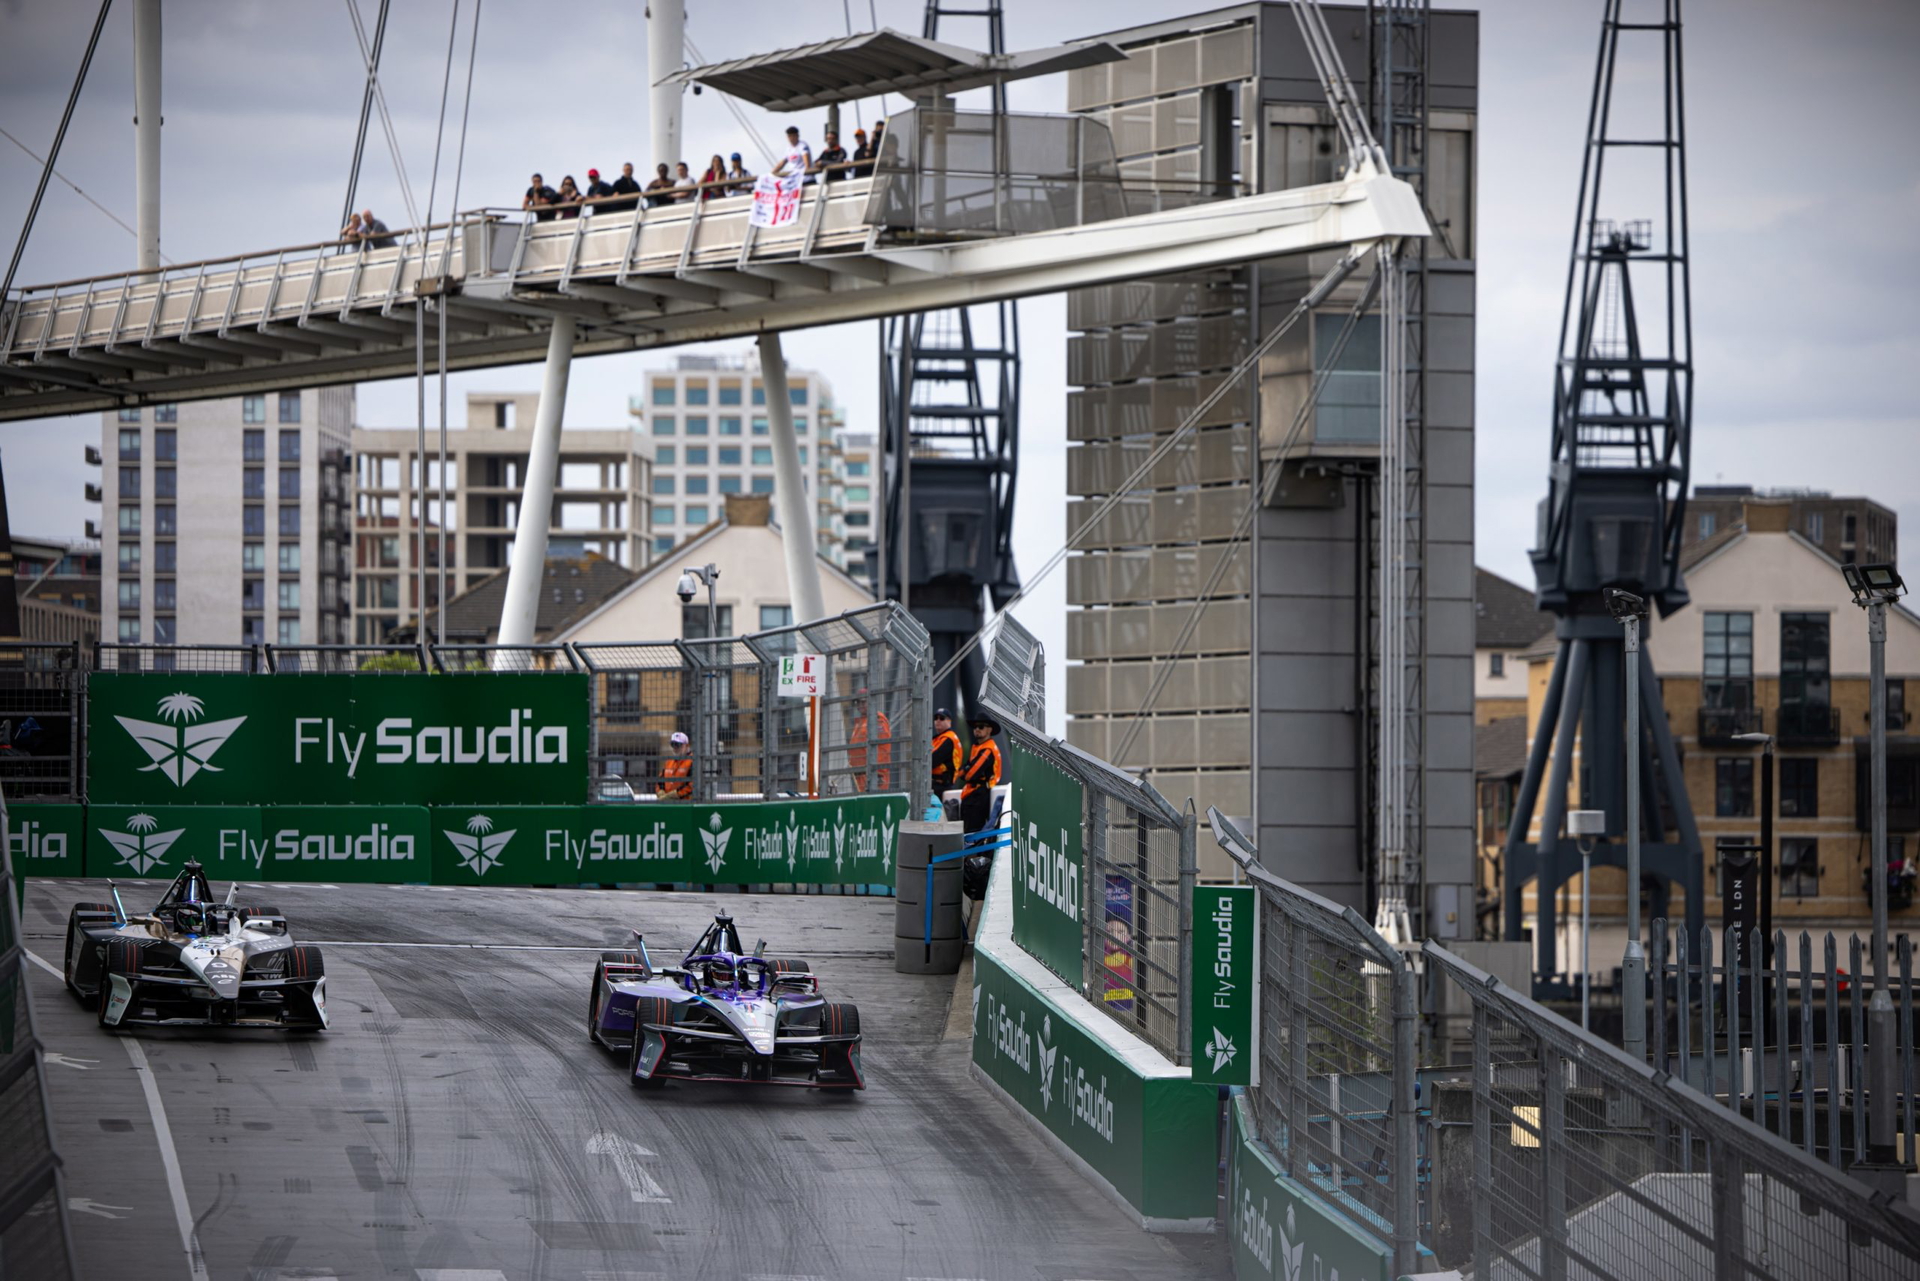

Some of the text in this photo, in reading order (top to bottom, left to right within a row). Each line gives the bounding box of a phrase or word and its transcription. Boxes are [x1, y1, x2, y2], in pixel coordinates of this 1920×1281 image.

[782, 677, 794, 685] EX
[797, 675, 816, 684] FIRE
[295, 708, 569, 778] Fly Saudia
[8, 822, 67, 858] dia
[219, 823, 415, 869] Fly Saudia
[545, 821, 684, 870] Fly Saudia
[1028, 821, 1078, 922] Saudia
[1733, 879, 1743, 911] LDN
[1212, 896, 1236, 1009] Fly Saudia
[611, 1006, 635, 1018] PORS
[999, 1003, 1031, 1075] Saudia
[1076, 1066, 1114, 1144] Saudia
